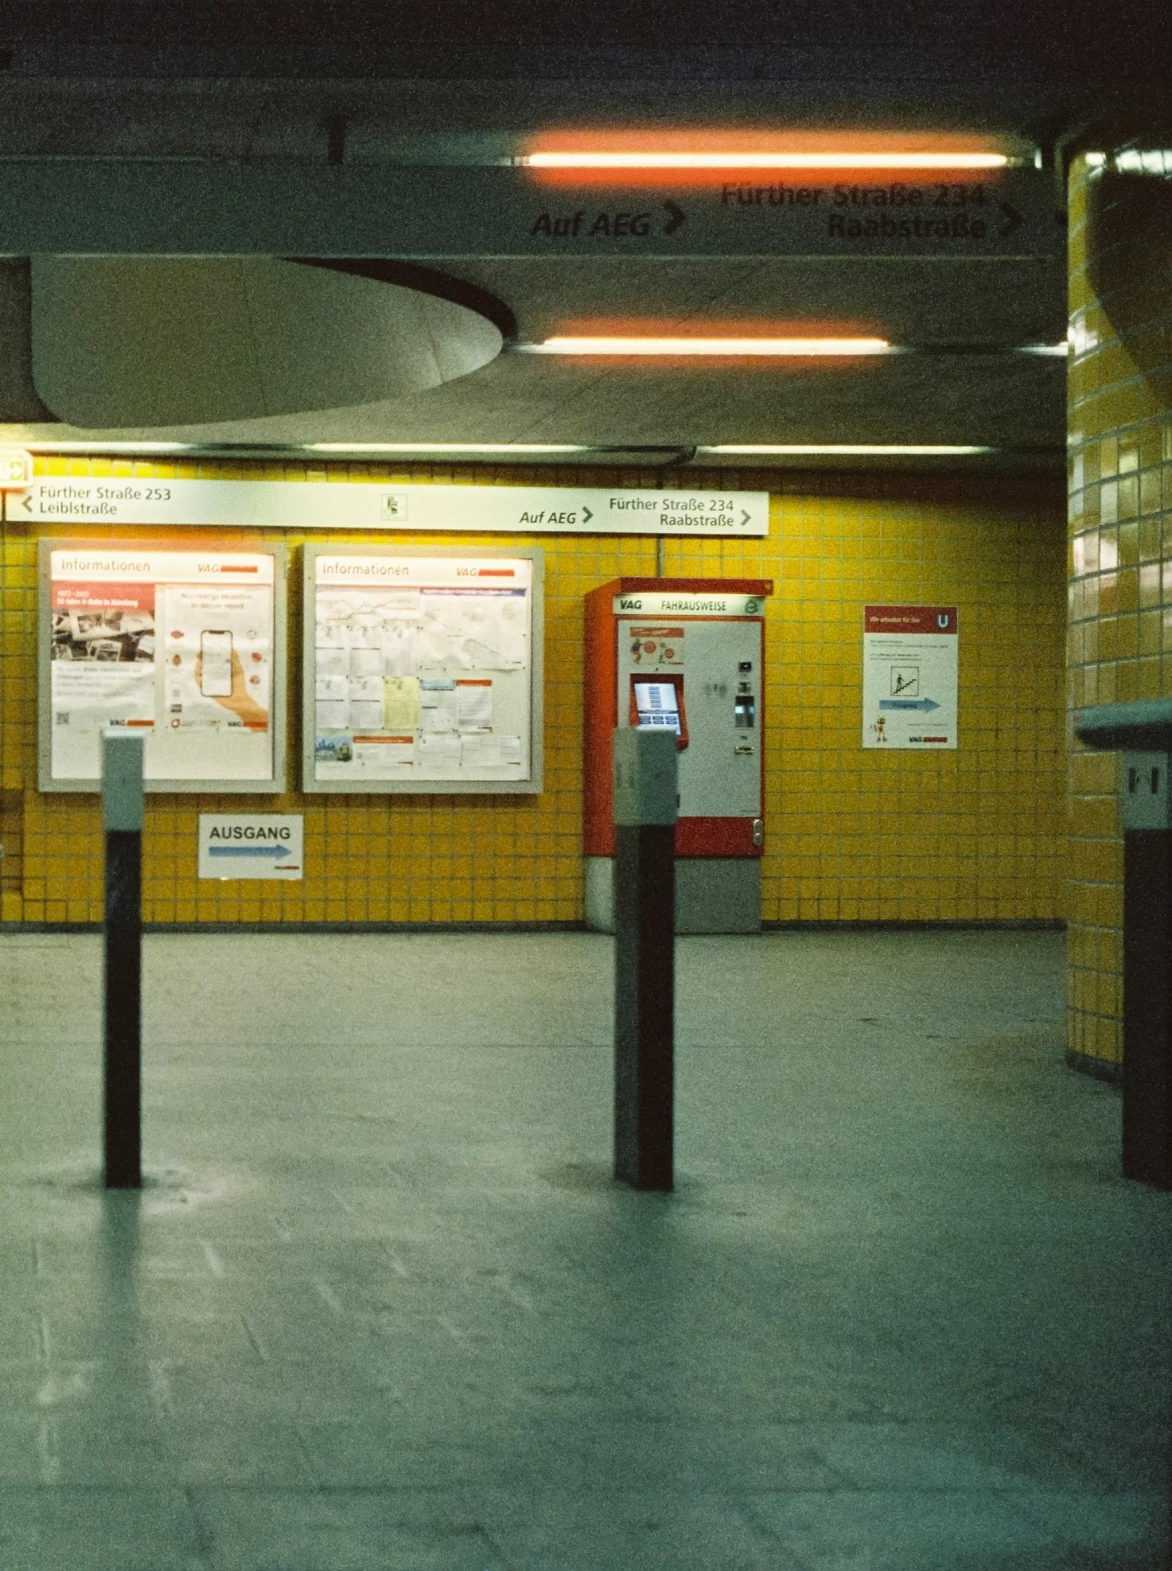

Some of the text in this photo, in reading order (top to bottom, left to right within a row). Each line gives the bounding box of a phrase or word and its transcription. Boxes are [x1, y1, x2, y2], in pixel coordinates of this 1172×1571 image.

[722, 182, 986, 208] Fürther Straße 234
[532, 210, 650, 236] Auf AEG
[828, 213, 987, 238] Raabstraße
[39, 485, 172, 501] Fürther Straße 253
[39, 501, 118, 516] Leiblstraße
[609, 497, 734, 512] Fürther Straße 234
[519, 511, 577, 525] Auf AEG
[660, 512, 735, 527] Raabstraße
[61, 559, 220, 573] Informationen VAG
[323, 563, 477, 577] Informationen VAG
[620, 600, 642, 610] VAG
[661, 600, 727, 611] FAHRAUSWEISE
[938, 615, 948, 628] U
[209, 826, 291, 840] AUSGANG
